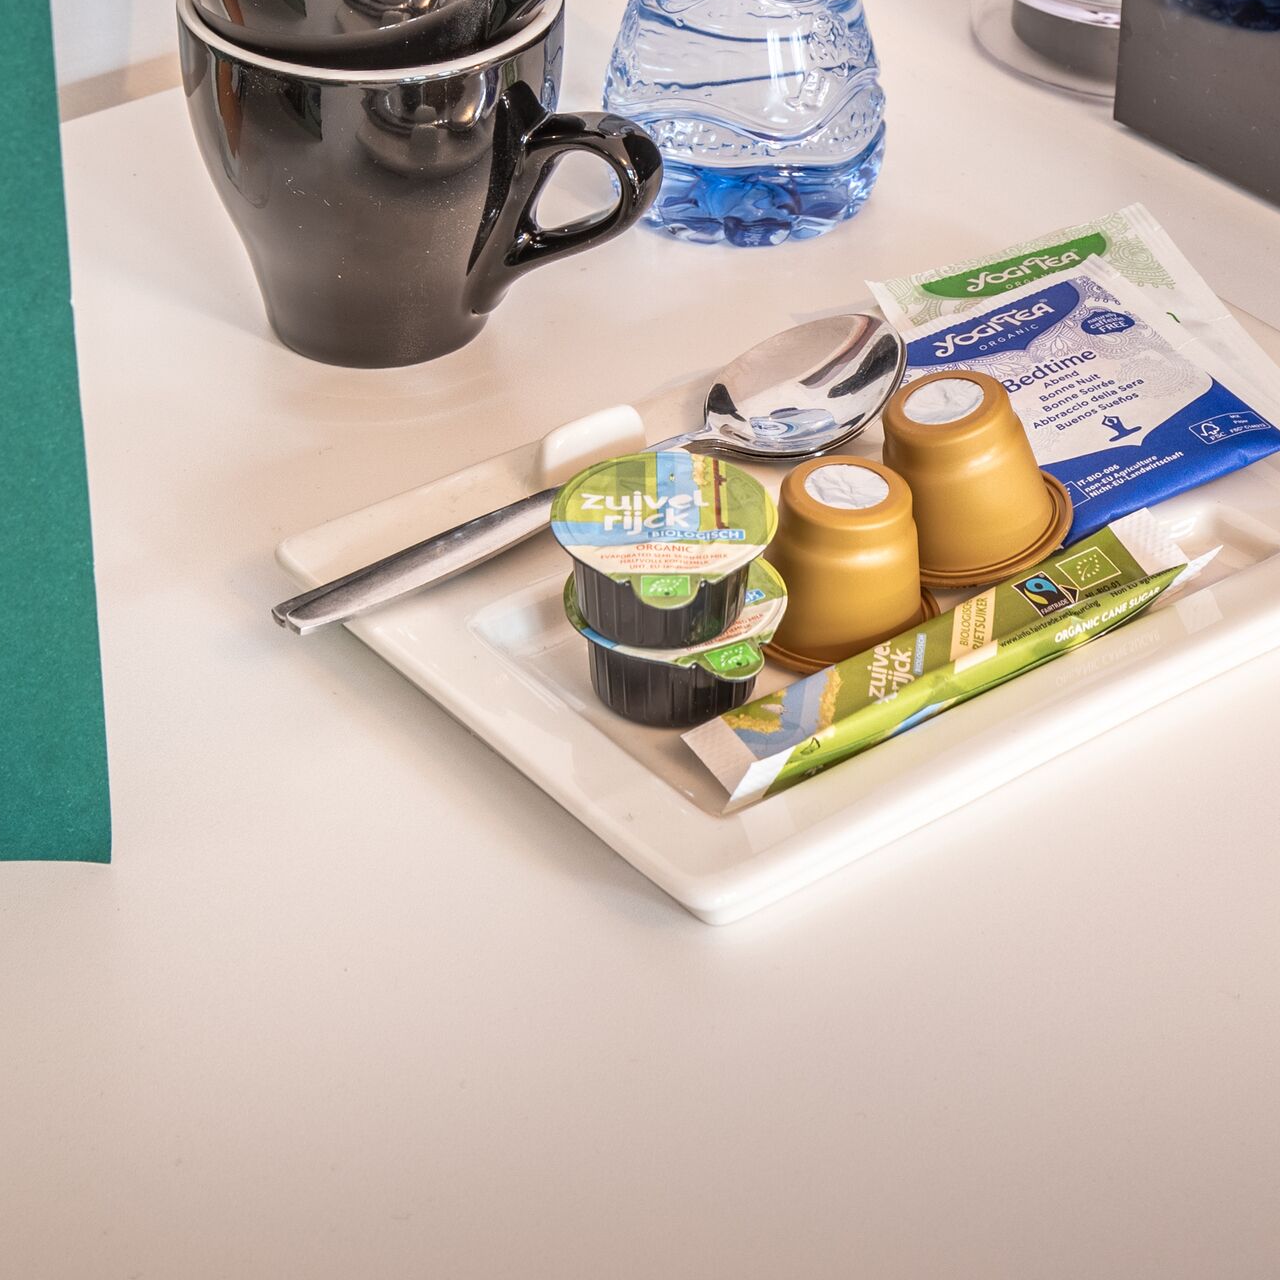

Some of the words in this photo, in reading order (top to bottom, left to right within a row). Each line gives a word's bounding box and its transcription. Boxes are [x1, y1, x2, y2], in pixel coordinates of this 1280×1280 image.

[979, 323, 1039, 351] ORGANIC
[1099, 321, 1128, 333] FREE
[1001, 350, 1097, 394] Bedtime
[1043, 370, 1080, 389] Abend
[1039, 383, 1075, 402] Bonne
[1076, 373, 1101, 387] Nuit
[1042, 393, 1078, 412] Bonne
[1079, 379, 1116, 395] Soirée
[1033, 400, 1089, 429] Abbraccio
[1091, 389, 1118, 403] della
[1118, 378, 1144, 392] Sera
[1056, 409, 1098, 431] Buenos
[1098, 392, 1139, 411] Sueños
[1077, 464, 1120, 487] IT-BIO-006
[1084, 475, 1115, 493] non-EU
[1114, 455, 1158, 479] Agriculture
[1089, 451, 1184, 498] Nicht-EU-Landwirtschaft
[580, 490, 709, 510] zuivel
[604, 508, 689, 535] rijck
[651, 529, 740, 541] BIOLOGISCH
[635, 544, 693, 553] ORGANIC
[1110, 587, 1126, 598] Non
[1041, 599, 1070, 615] FAIRTRADE
[1055, 617, 1099, 643] ORGANIC
[1101, 603, 1127, 623] CANE
[1129, 586, 1160, 609] SUGAR
